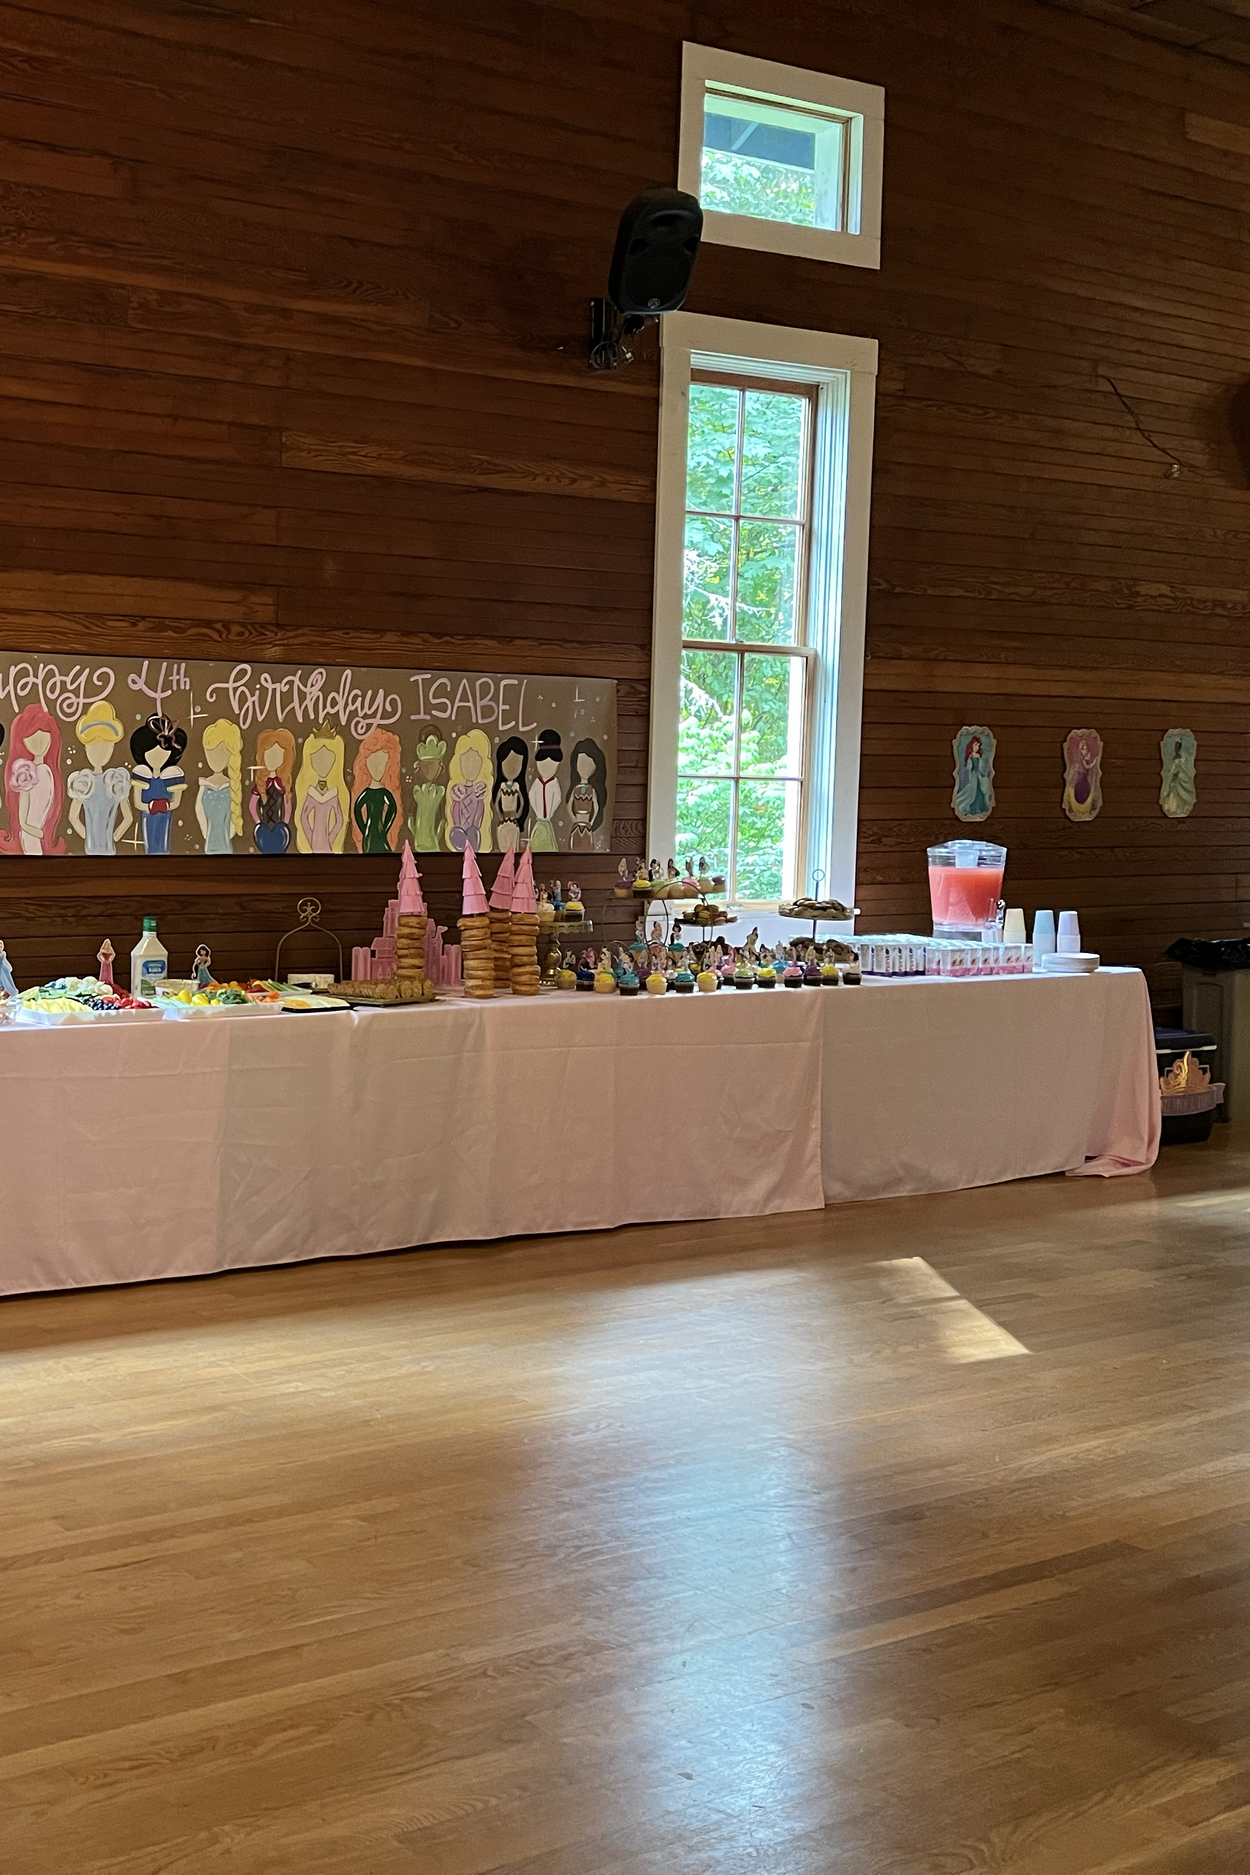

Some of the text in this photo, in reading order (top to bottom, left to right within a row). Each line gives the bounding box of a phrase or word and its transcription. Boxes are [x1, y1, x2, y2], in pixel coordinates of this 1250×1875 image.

[127, 660, 190, 717] 4th
[207, 664, 401, 739] birthday
[410, 674, 537, 731] ISABEL
